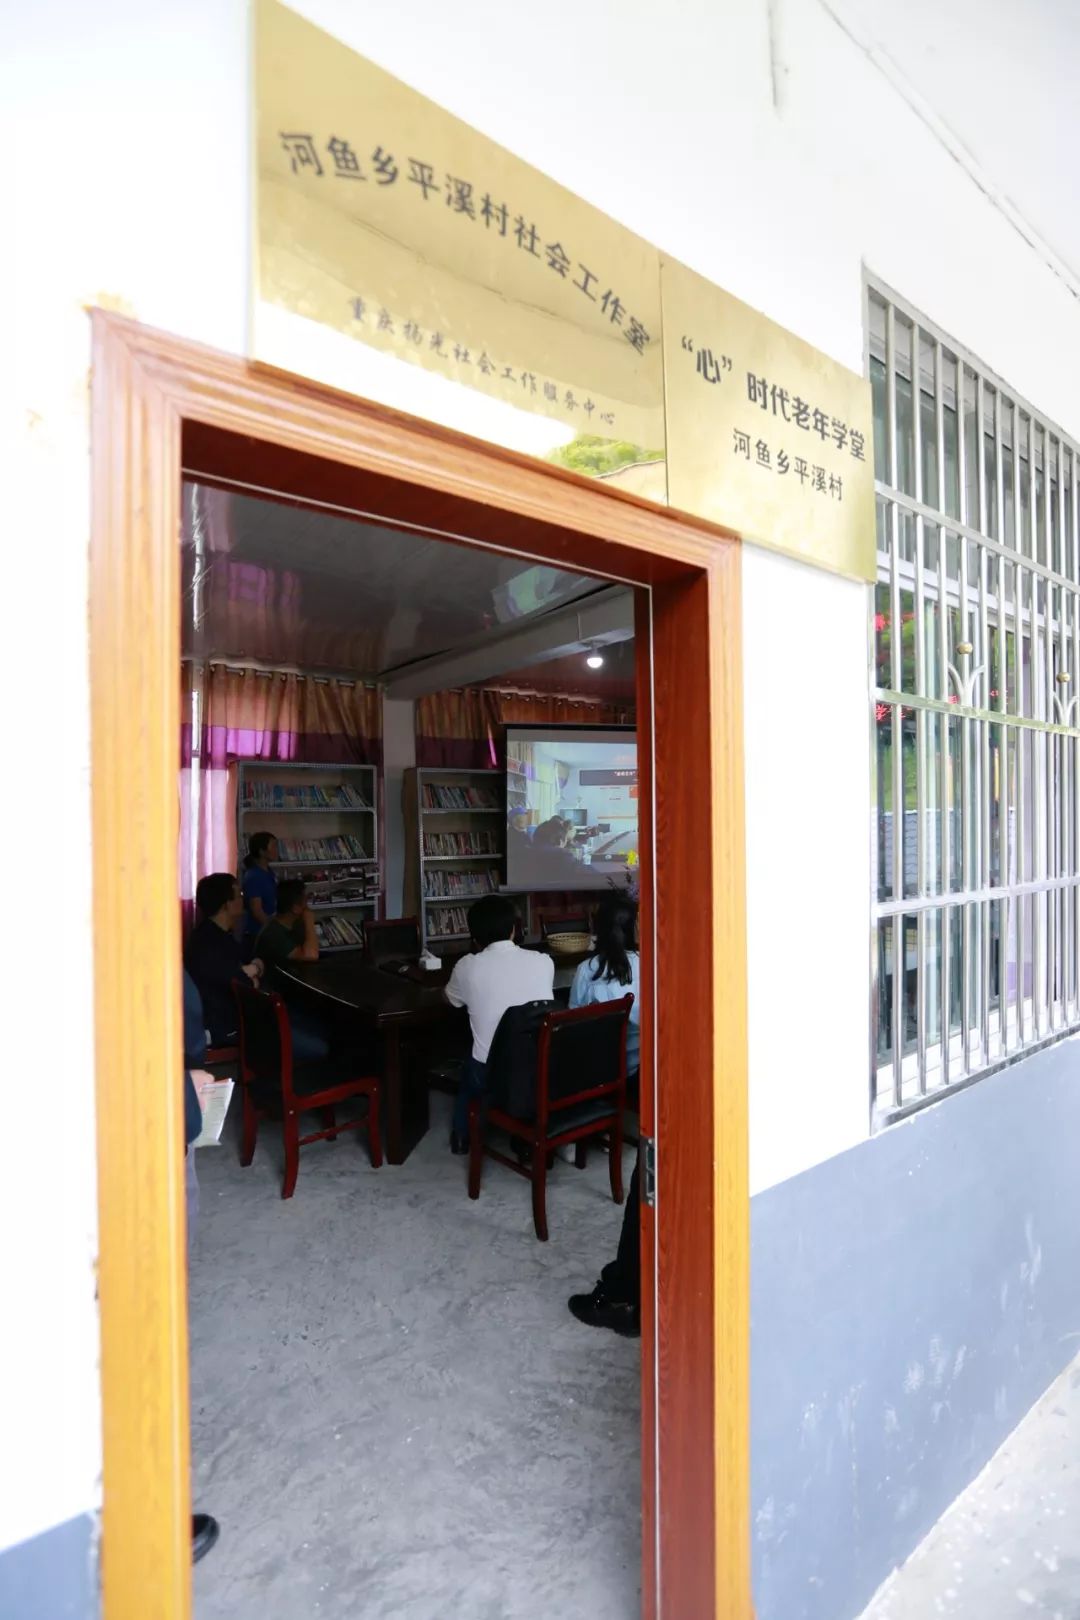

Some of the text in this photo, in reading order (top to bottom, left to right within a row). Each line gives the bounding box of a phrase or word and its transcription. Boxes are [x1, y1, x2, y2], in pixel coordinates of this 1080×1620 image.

[279, 131, 651, 356] 河鱼乡平溪村社会工作室
[733, 428, 843, 501] 河鱼乡平溪村
